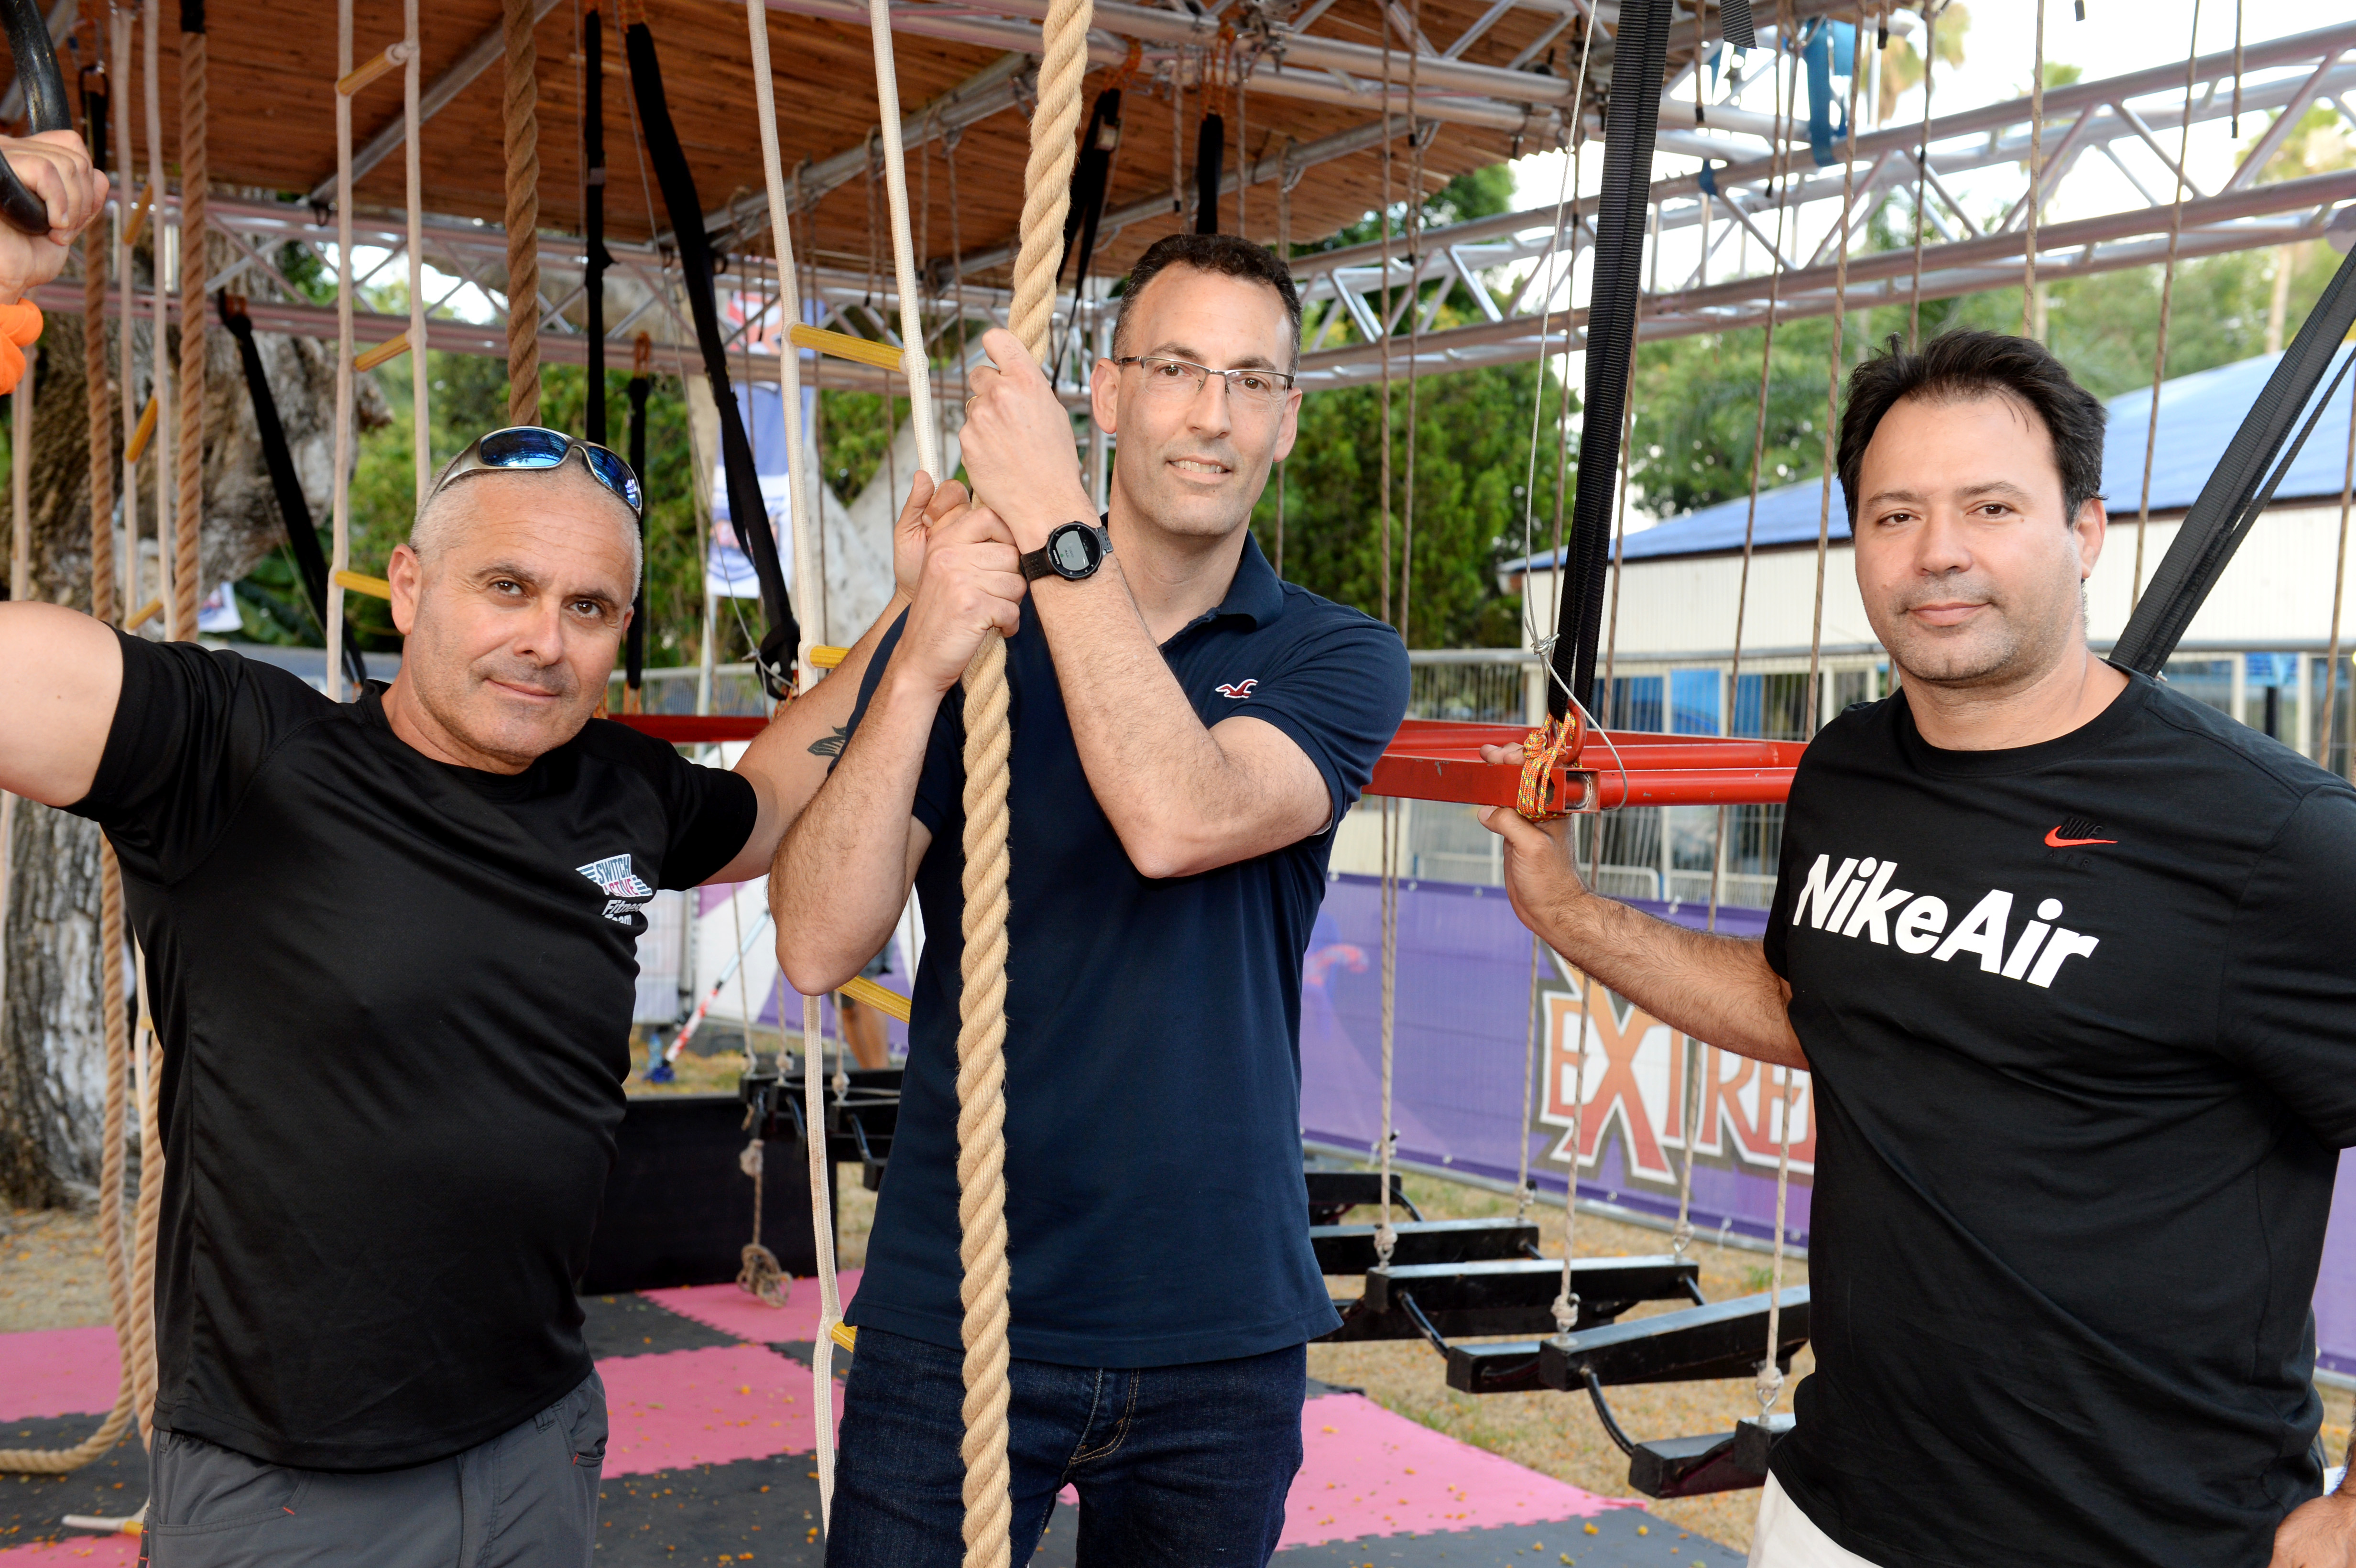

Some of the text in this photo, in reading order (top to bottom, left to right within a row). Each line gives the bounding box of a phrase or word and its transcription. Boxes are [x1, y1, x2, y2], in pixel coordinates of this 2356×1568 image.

[2059, 817, 2104, 839] NIKE
[2047, 849, 2090, 868] AIR
[596, 856, 631, 884] SWITCH
[601, 899, 643, 915] Fitnes
[1542, 951, 1817, 1183] EXTRE
